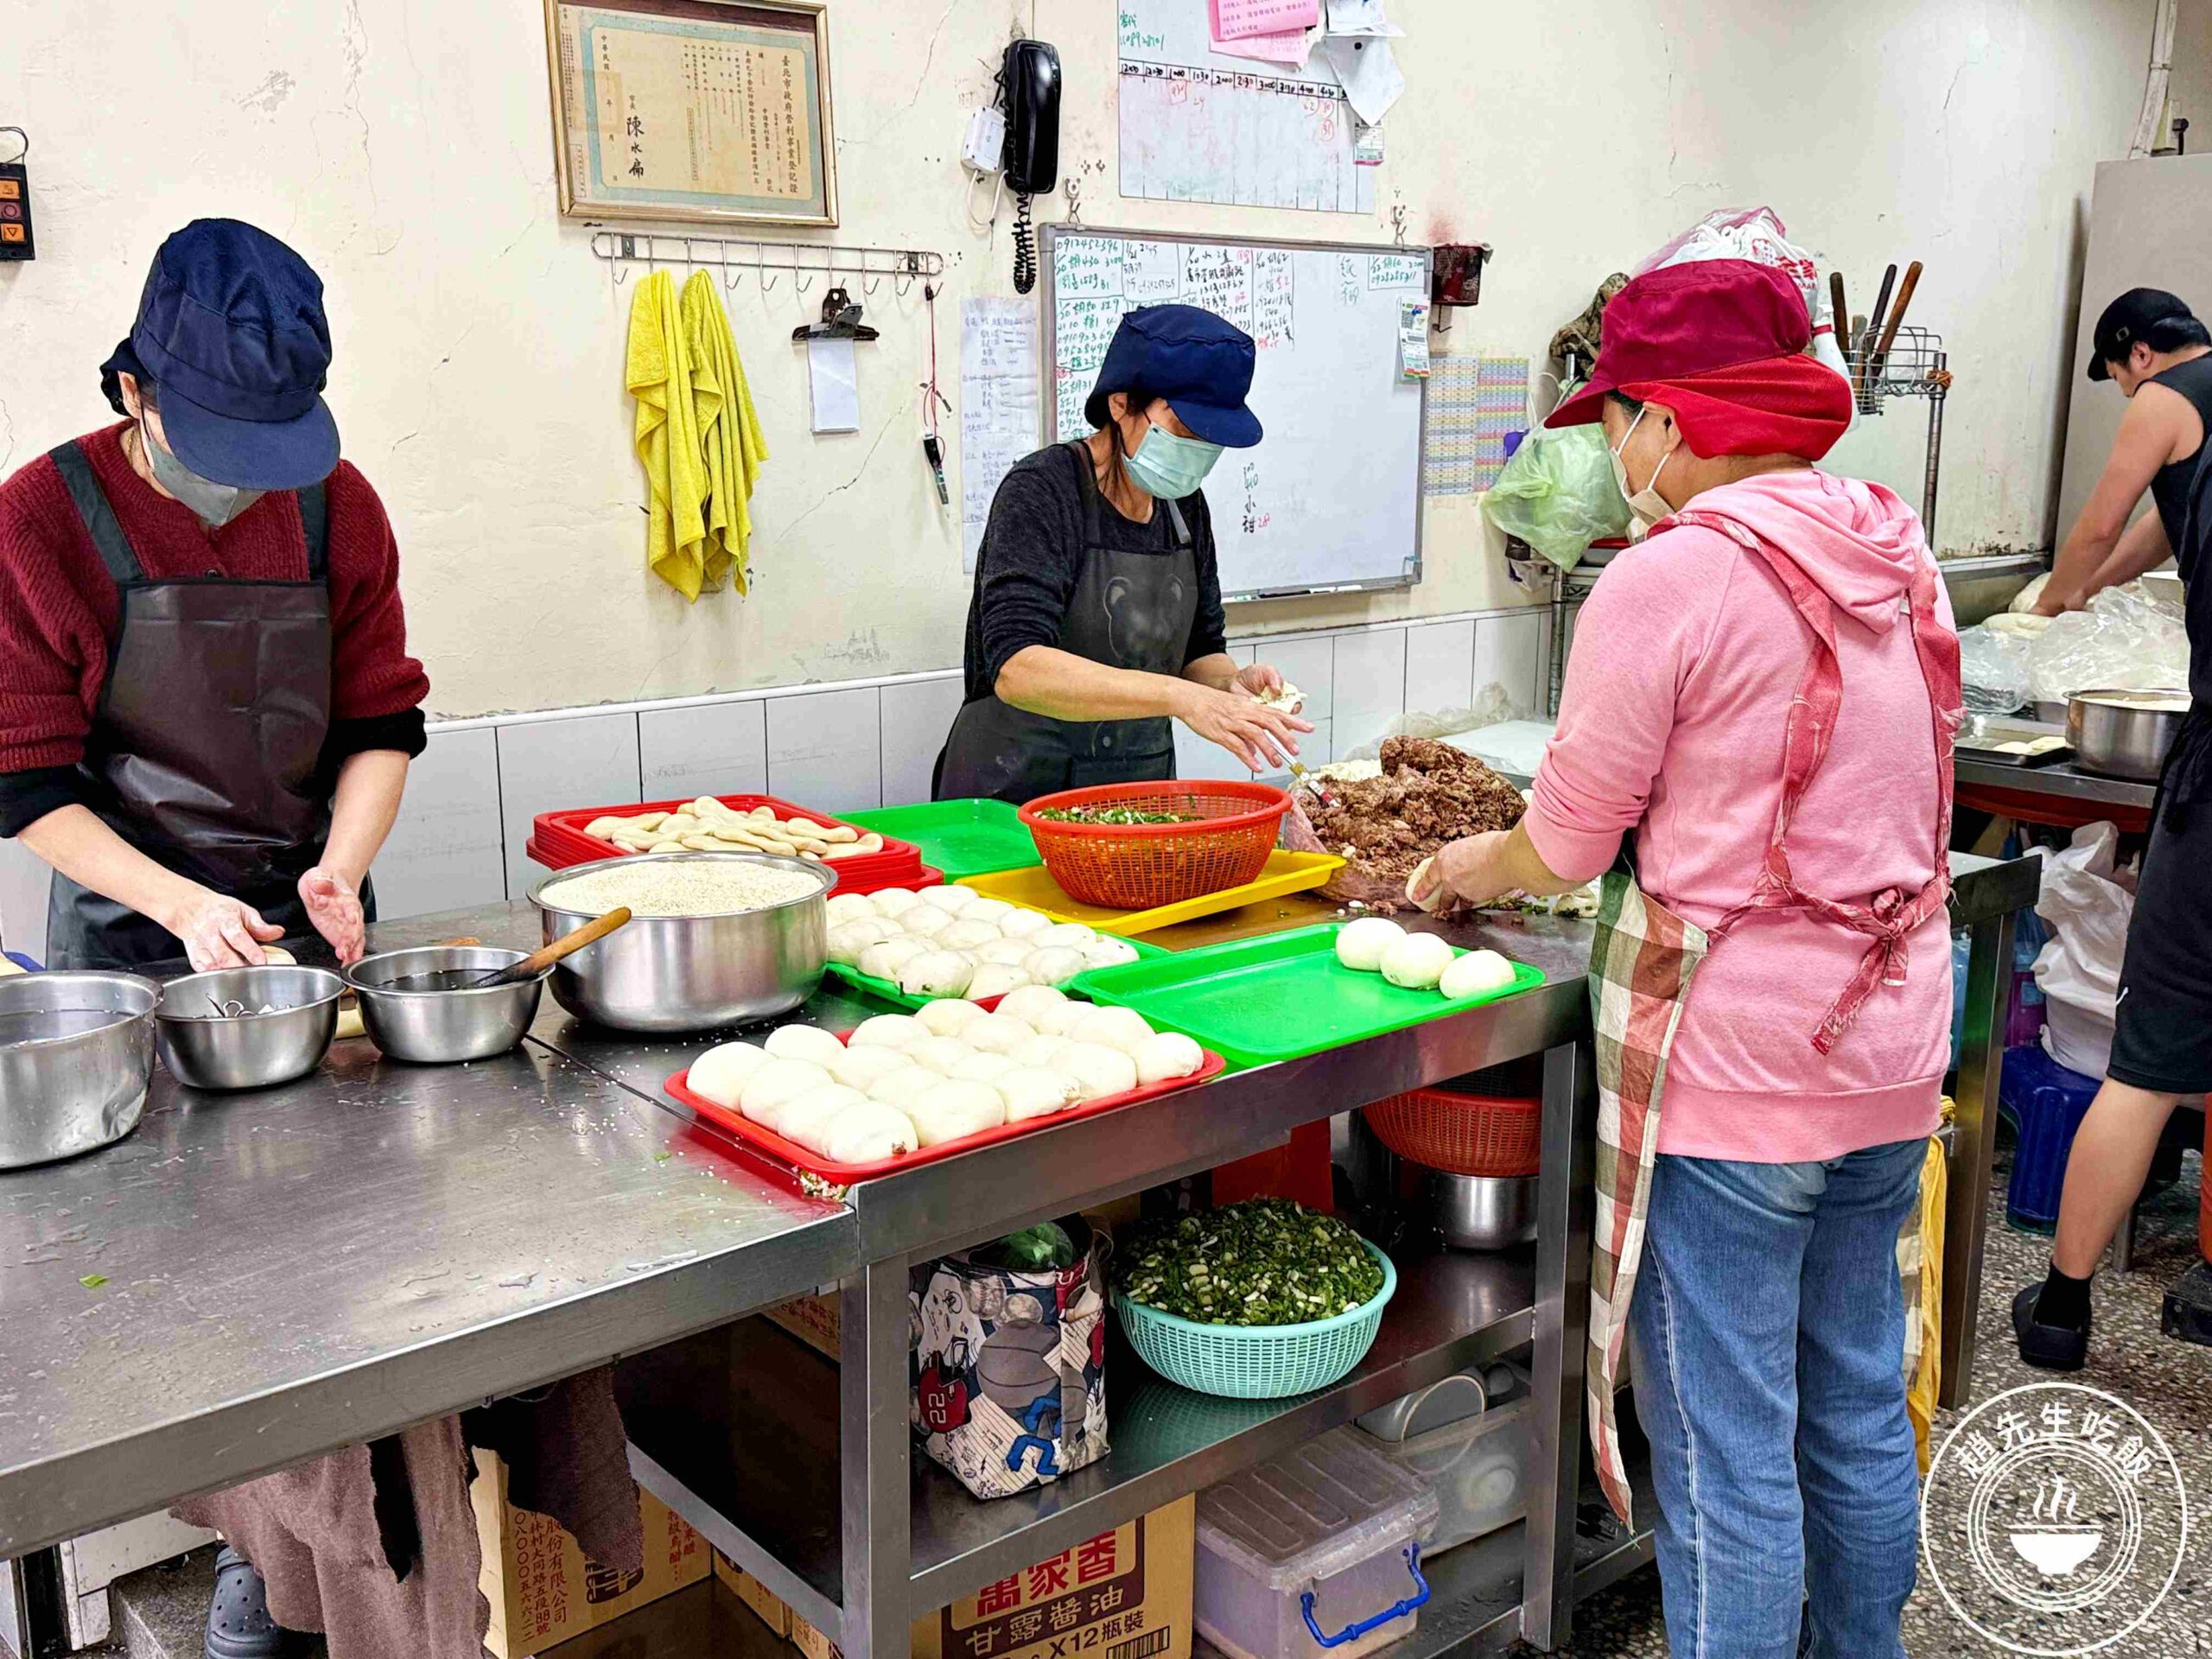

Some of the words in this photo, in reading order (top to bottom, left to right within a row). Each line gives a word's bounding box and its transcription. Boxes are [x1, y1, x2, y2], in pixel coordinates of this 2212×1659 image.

[626, 115, 645, 181] 陳水扁
[781, 54, 798, 194] 臺北市政府營利事業登記證
[545, 1518, 569, 1624] 股份有限公司
[965, 1585, 1123, 1656] 甘露醬油
